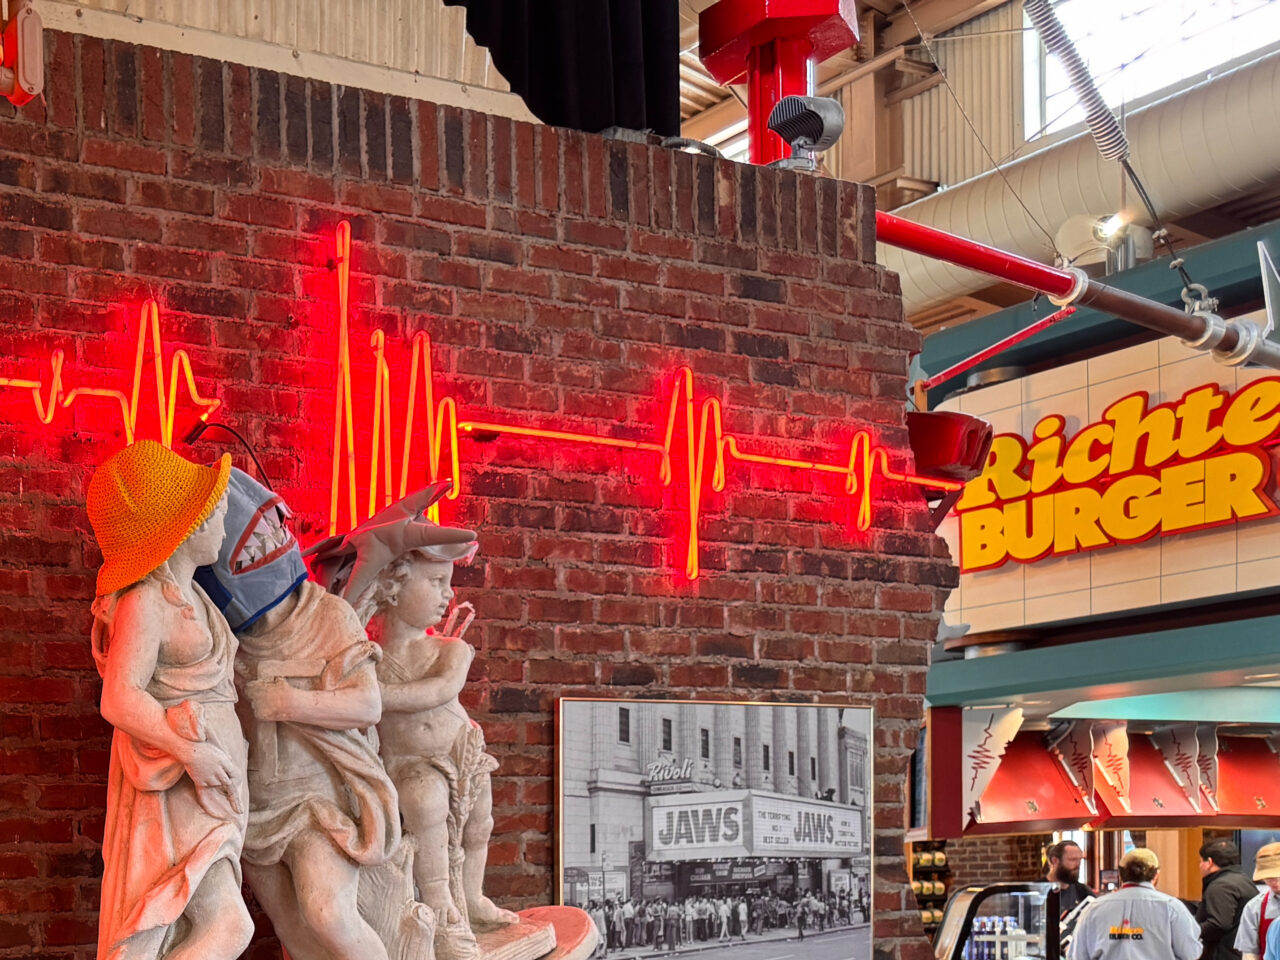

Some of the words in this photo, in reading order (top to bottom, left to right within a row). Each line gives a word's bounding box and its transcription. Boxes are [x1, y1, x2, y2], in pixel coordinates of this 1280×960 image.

[956, 380, 1280, 511] Richte
[962, 452, 1271, 570] BURGER
[647, 758, 694, 781] Rivoli
[658, 806, 739, 845] JAWS
[793, 811, 834, 844] JAWS
